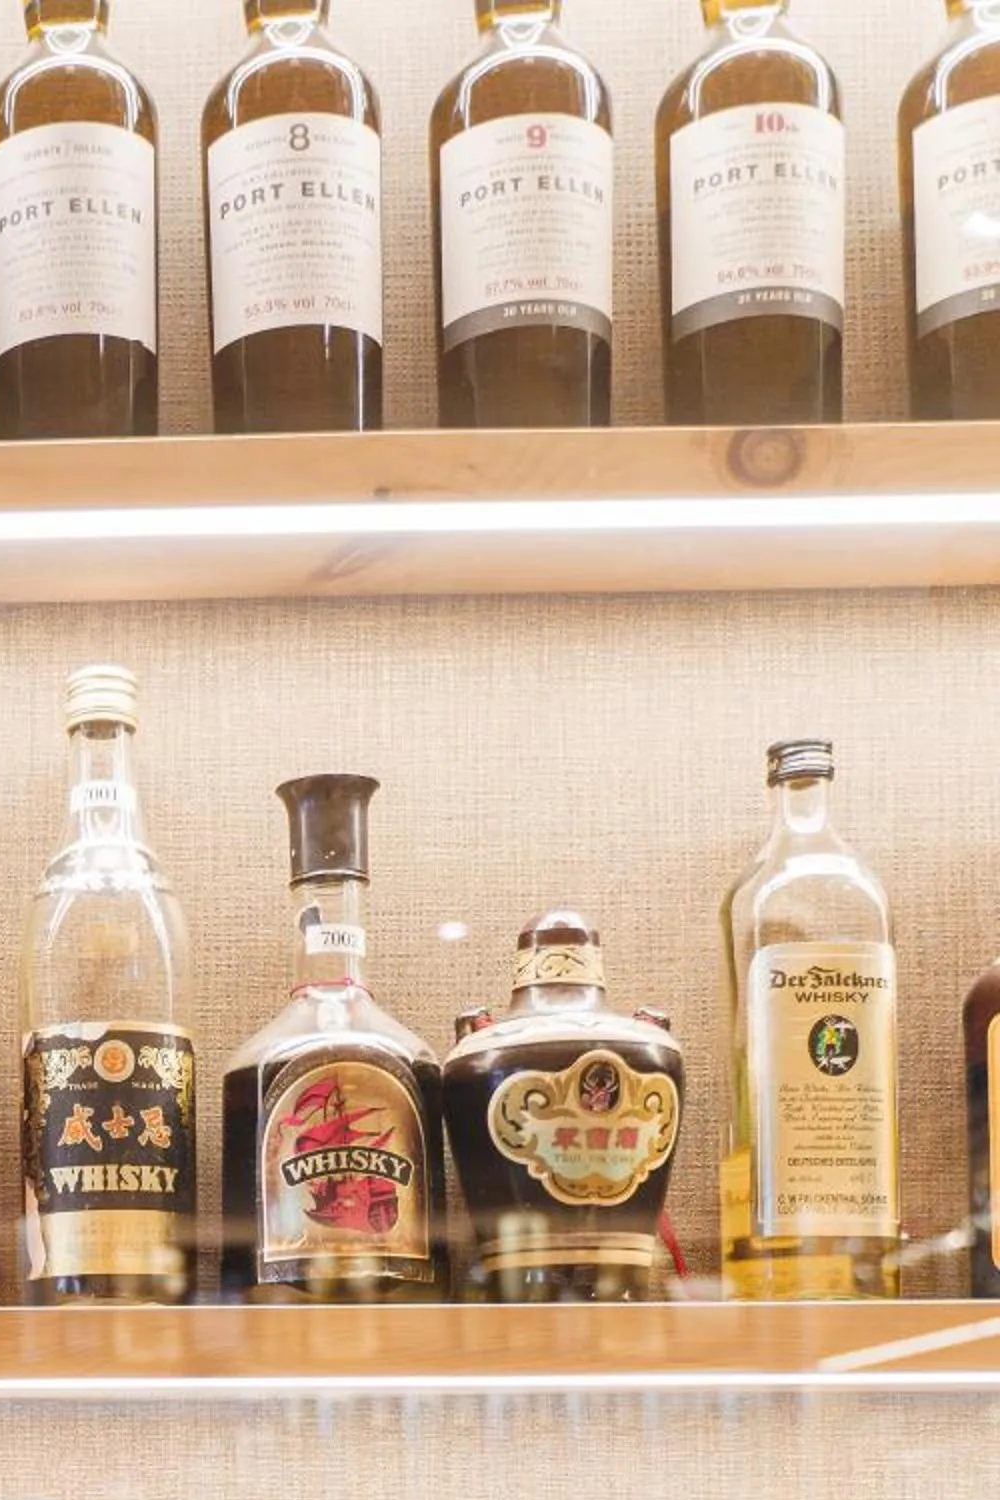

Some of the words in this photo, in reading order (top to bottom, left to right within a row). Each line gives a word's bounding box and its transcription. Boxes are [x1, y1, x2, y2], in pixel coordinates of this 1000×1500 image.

[289, 124, 310, 151] 8
[459, 176, 524, 208] PORT
[536, 174, 604, 204] ELLEN
[692, 164, 760, 194] PORT
[773, 161, 837, 189] ELLEN
[67, 197, 142, 225] ELLEN
[218, 182, 285, 220] PORT
[301, 180, 376, 215] ELLEN
[293, 296, 315, 308] vol
[770, 969, 805, 989] Der
[794, 990, 870, 1003] WHISKY
[49, 1163, 179, 1194] WHISKY
[284, 1149, 409, 1182] WHISKY
